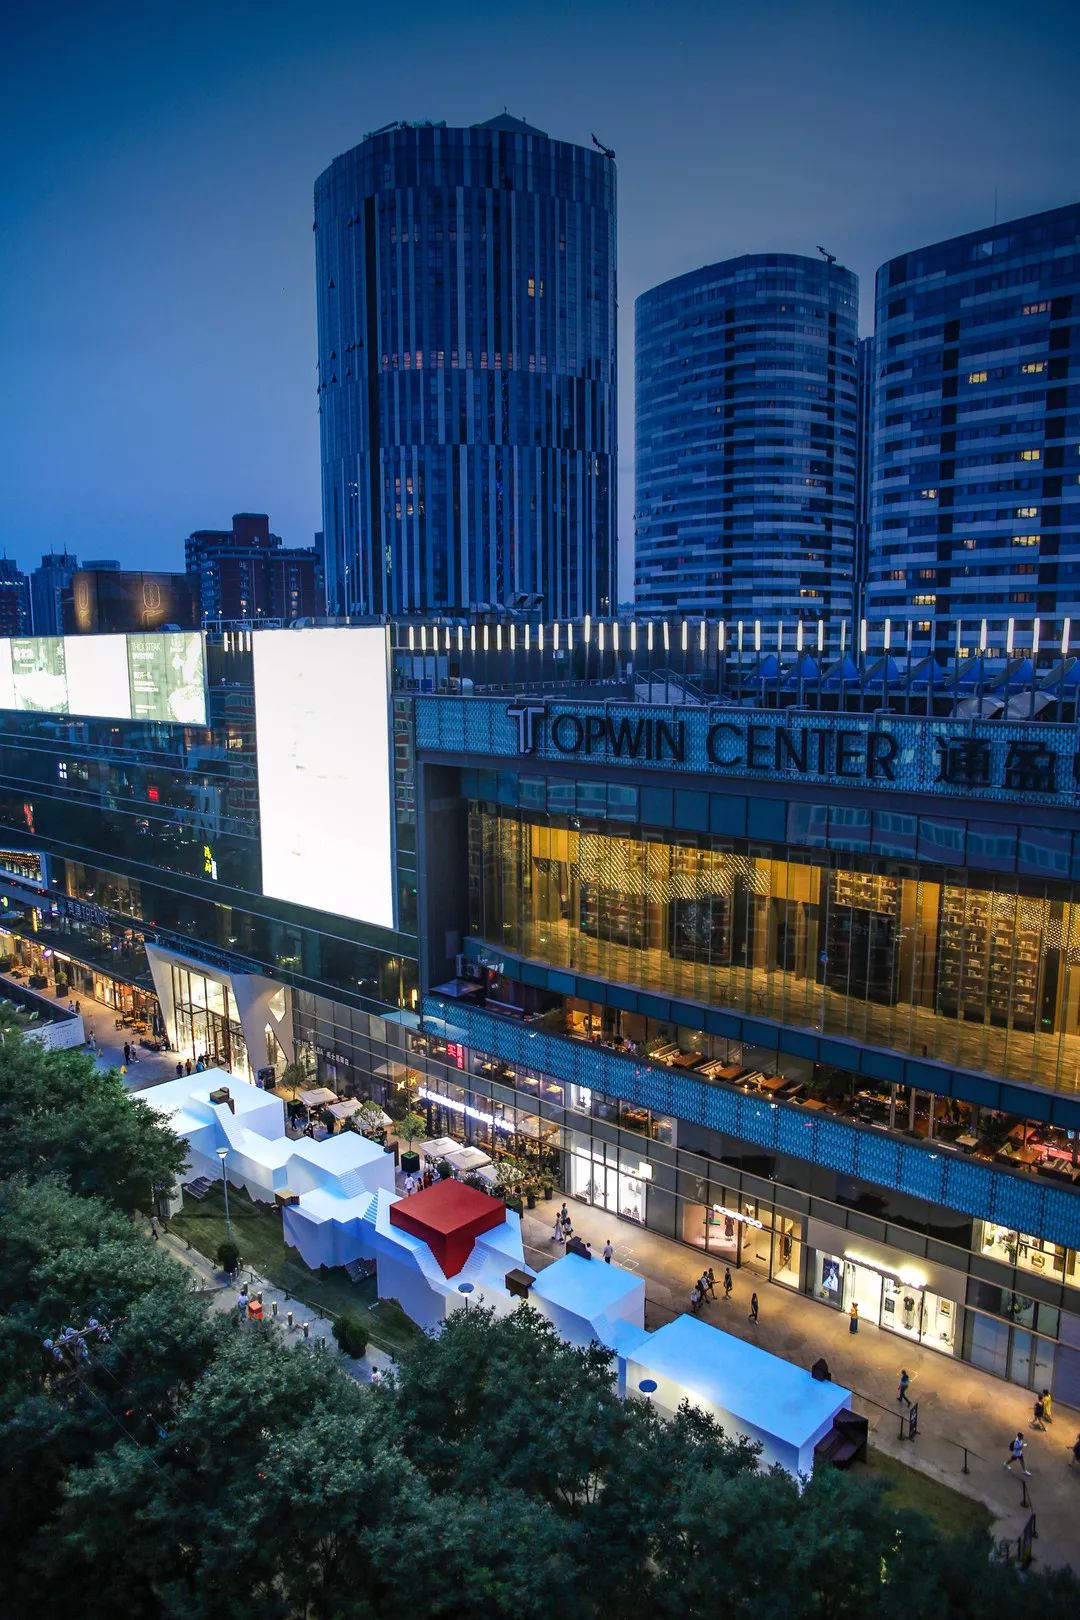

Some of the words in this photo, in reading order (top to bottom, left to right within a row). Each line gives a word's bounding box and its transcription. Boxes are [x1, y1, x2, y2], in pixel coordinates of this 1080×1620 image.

[507, 705, 686, 763] TOPWIN
[706, 722, 900, 781] CENTER
[934, 735, 1080, 794] 通盈
